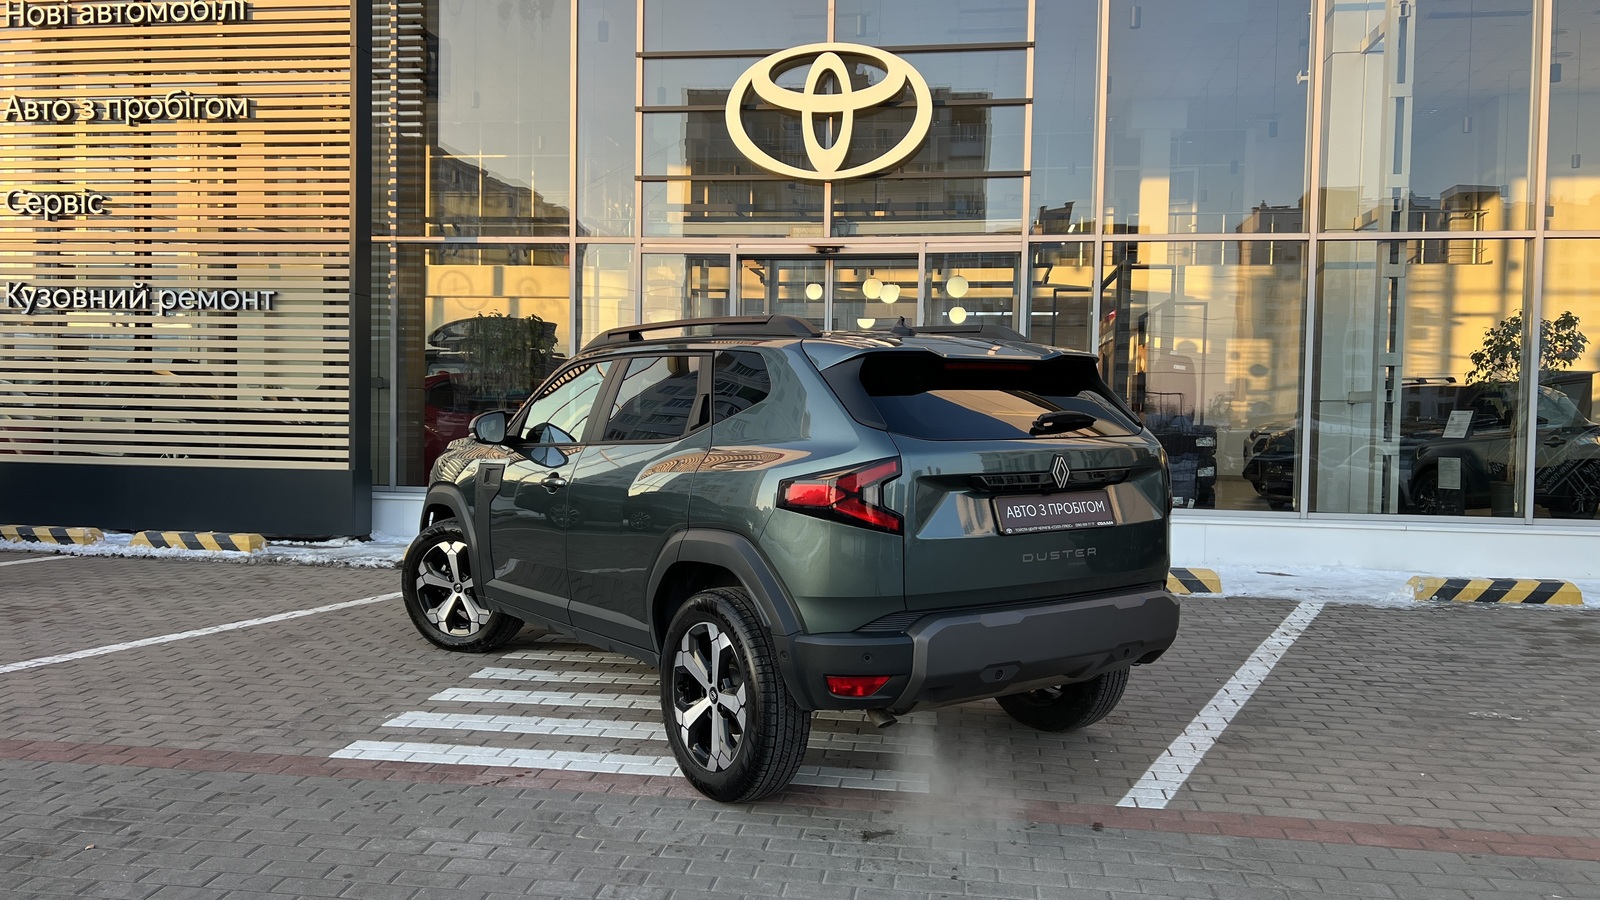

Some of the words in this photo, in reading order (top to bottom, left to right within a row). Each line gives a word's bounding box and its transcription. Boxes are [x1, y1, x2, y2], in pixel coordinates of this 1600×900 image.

[5, 0, 70, 27] Нові
[79, 0, 248, 25] автомобілі
[3, 94, 71, 121] Авто
[80, 99, 97, 120] з
[106, 90, 249, 126] пробігом
[6, 188, 104, 221] Сервіс
[5, 281, 149, 315] Кузовний
[159, 290, 275, 316] ремонт
[1007, 504, 1037, 519] АВТО
[1048, 501, 1106, 515] ПРОБІГОМ
[1022, 547, 1097, 563] DUSTER
